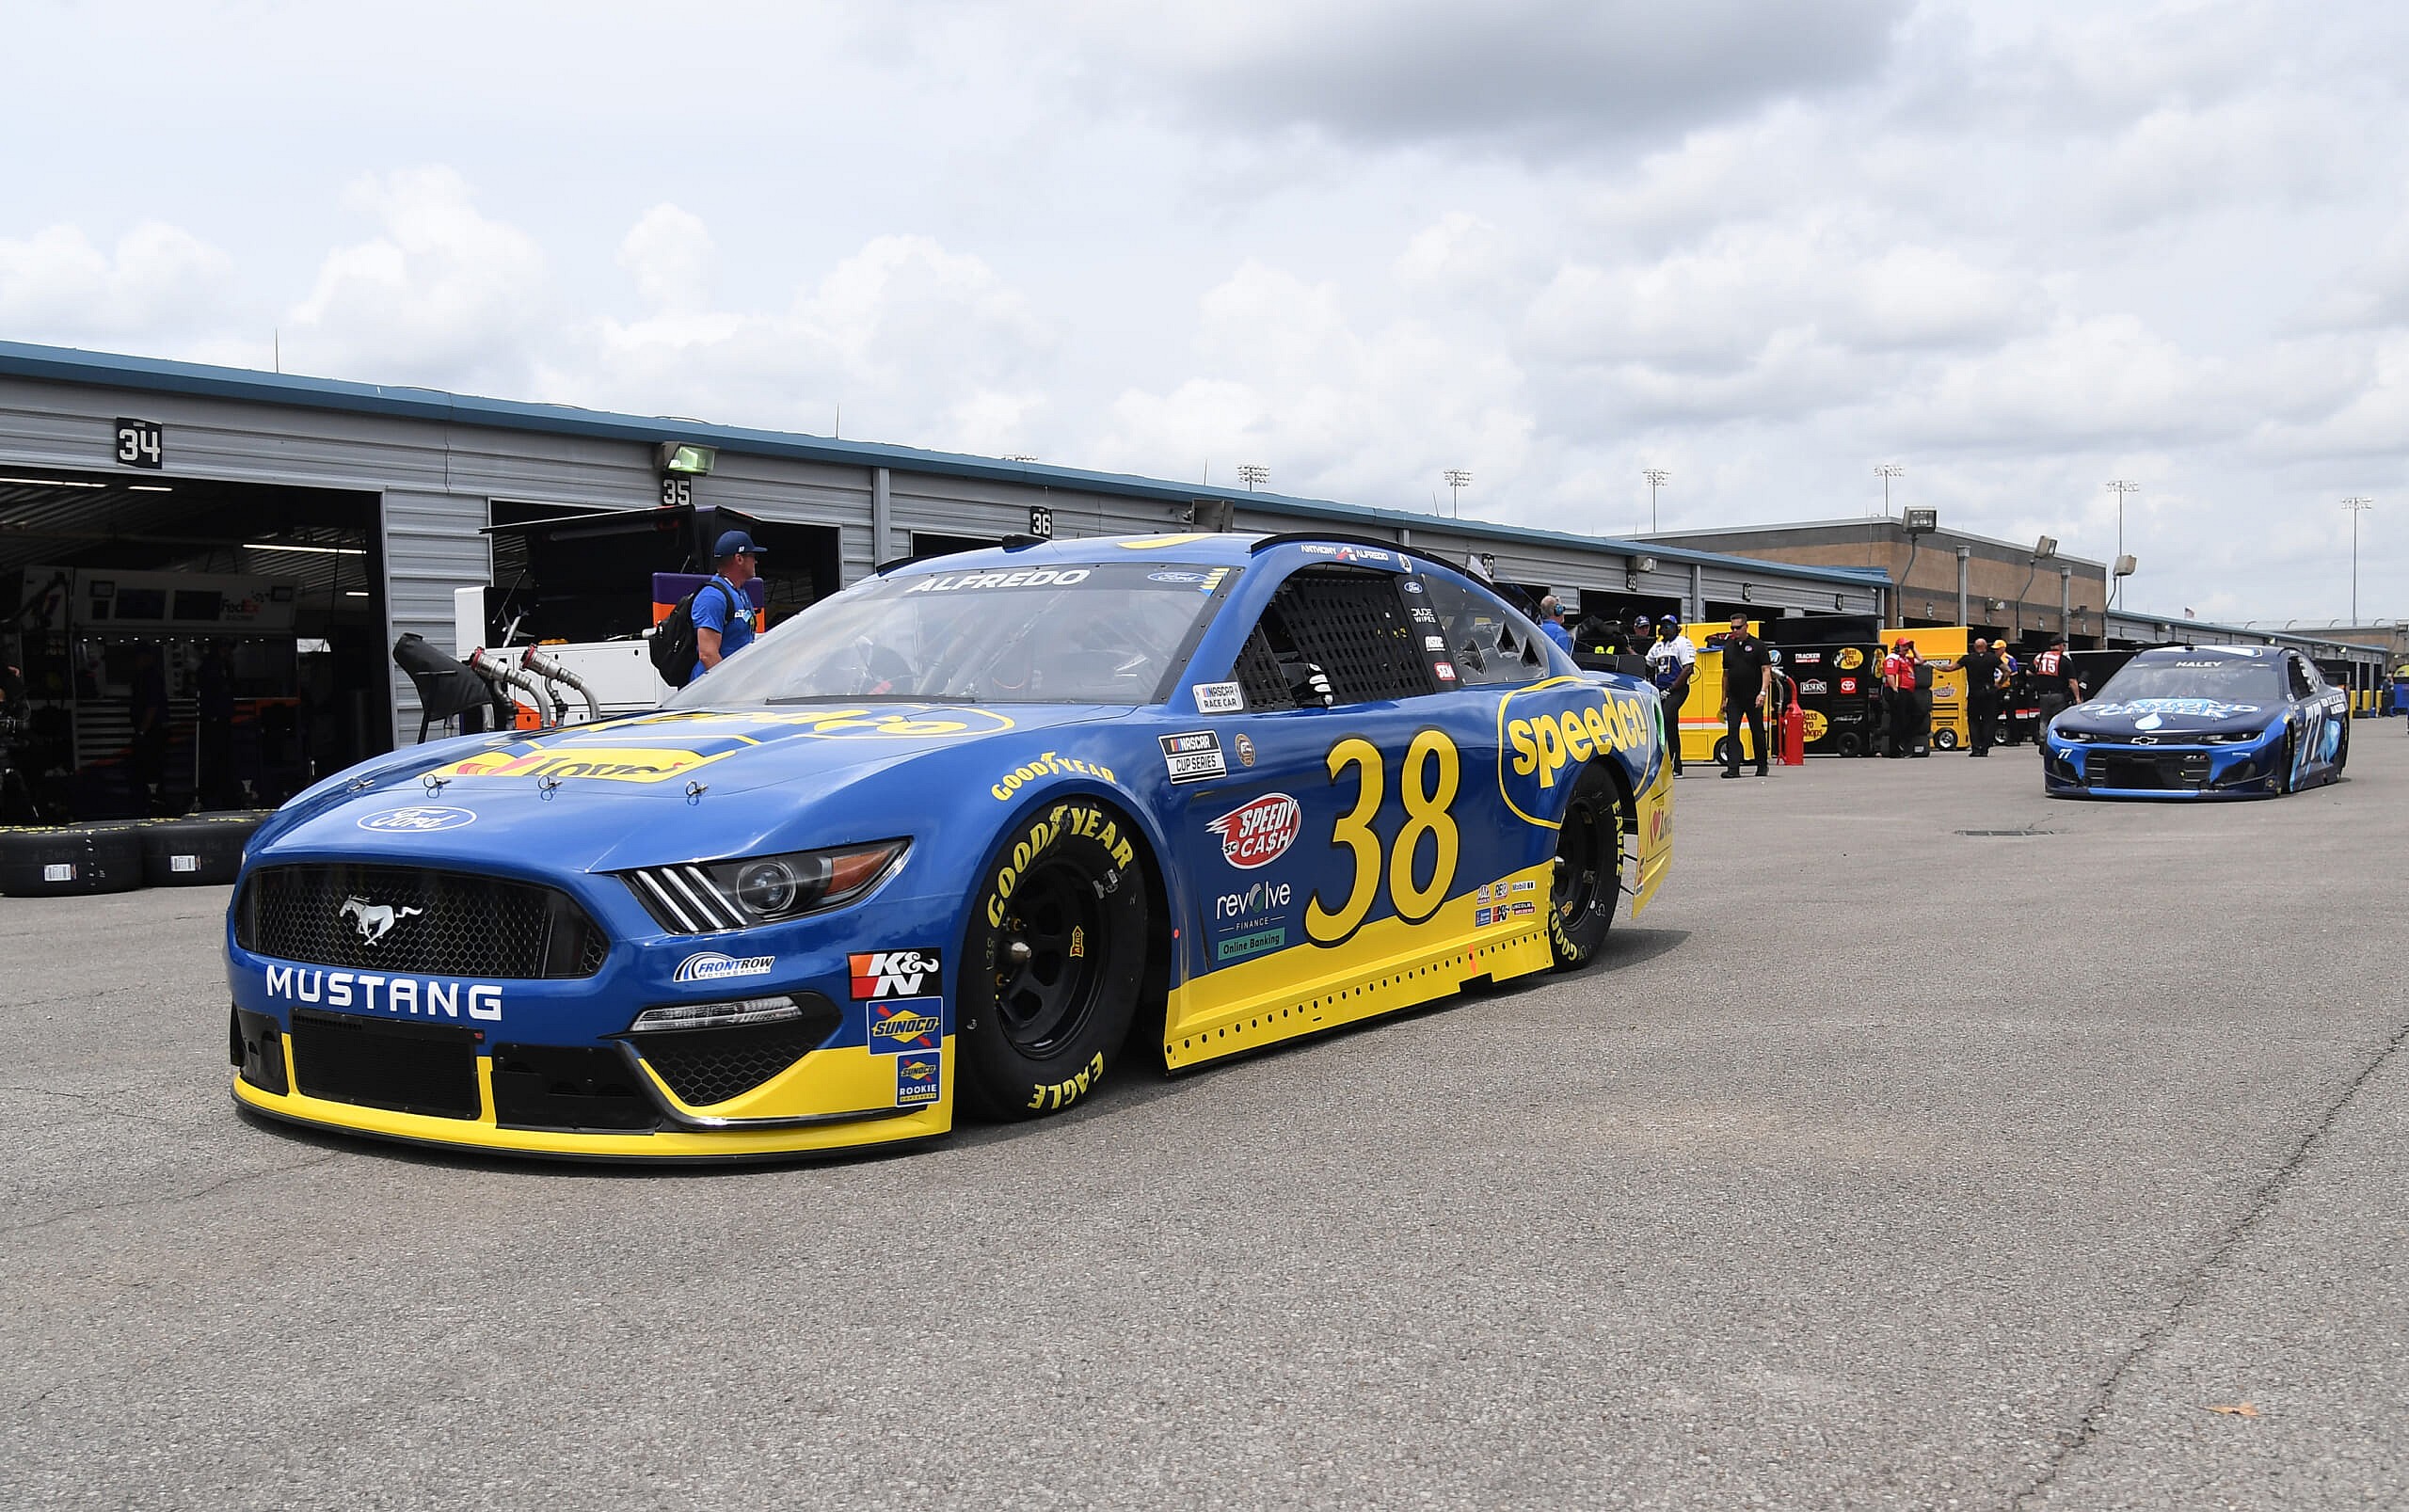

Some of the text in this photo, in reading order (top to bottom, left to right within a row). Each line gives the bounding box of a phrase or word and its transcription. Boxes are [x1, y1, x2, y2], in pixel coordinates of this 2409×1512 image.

[120, 429, 160, 462] 34
[663, 479, 690, 505] 35
[1032, 513, 1051, 535] 36
[1301, 545, 1336, 555] ANTHONY
[1356, 550, 1389, 561] ALFREDO
[906, 569, 1091, 593] ALFREDO
[1627, 574, 1637, 589] 39
[1411, 608, 1433, 617] DUDE
[2040, 660, 2056, 674] 15
[1207, 685, 1236, 698] NASCAR
[1204, 698, 1237, 708] RACE CAR
[1804, 711, 1818, 721] ass
[1179, 735, 1211, 752] NASCAR
[1508, 689, 1647, 788] speedco
[1176, 755, 1217, 772] CUP SERIES
[2057, 748, 2073, 759] 77
[992, 752, 1117, 801] GOODYEAR
[365, 807, 466, 830] Ford
[1239, 800, 1298, 838] SPEEDY
[1241, 829, 1291, 857] CA$H
[1304, 729, 1460, 943] 38
[1611, 800, 1624, 877] EAGLE
[1225, 841, 1237, 854] SC
[987, 804, 1133, 929] GOODYEAR
[1235, 917, 1269, 931] FINANCE
[1223, 934, 1280, 955] Online Banking
[266, 964, 503, 1022] MUSTANG
[872, 1017, 938, 1037] SUNOCO
[901, 1065, 935, 1076] SUNOCO
[1028, 1049, 1105, 1109] EAGLE
[900, 1084, 937, 1095] ROOKIE
